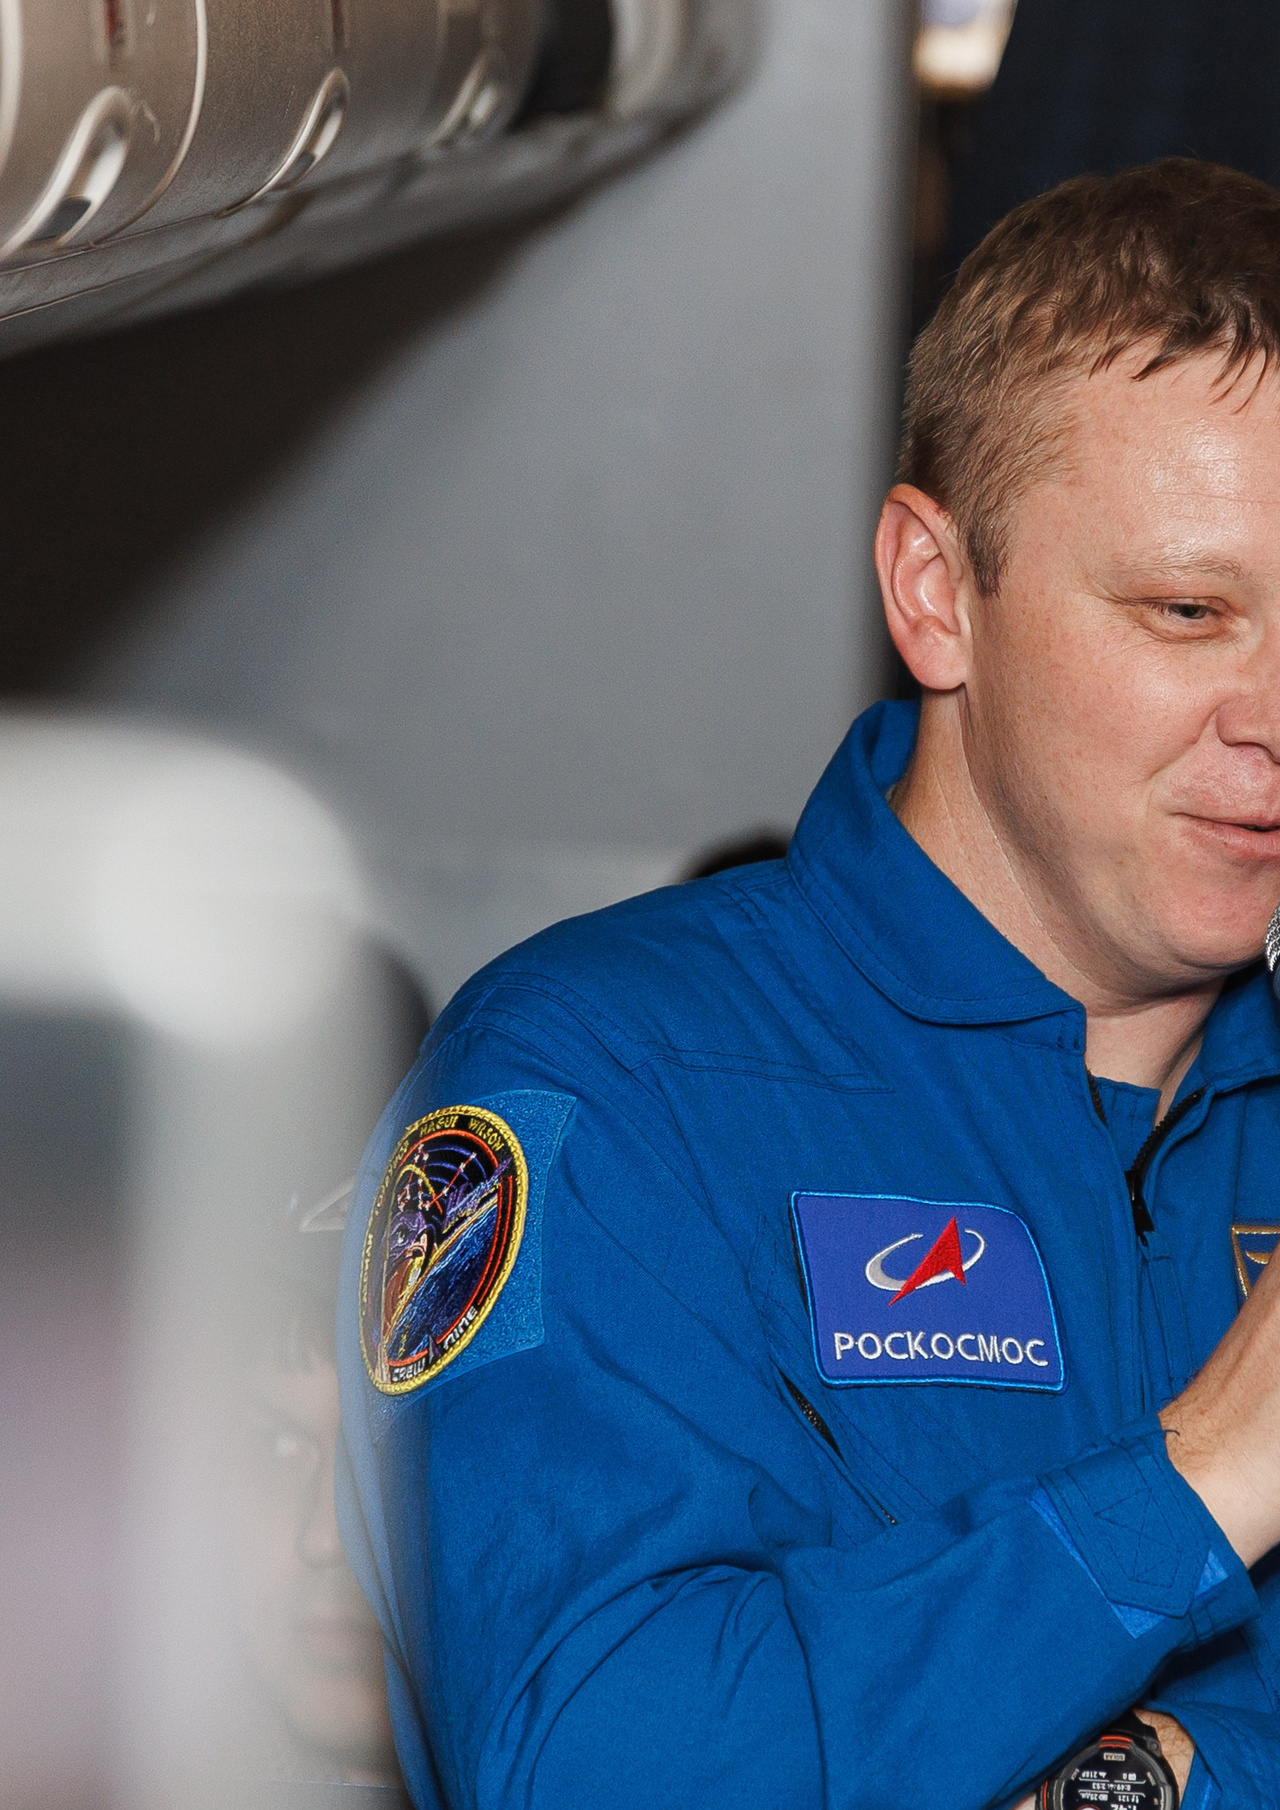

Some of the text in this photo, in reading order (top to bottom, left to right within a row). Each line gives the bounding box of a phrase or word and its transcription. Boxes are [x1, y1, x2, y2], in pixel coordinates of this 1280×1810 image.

[467, 1117, 505, 1152] WILSON
[833, 1330, 1049, 1367] РОСКОСМОС
[392, 1357, 426, 1382] CREW
